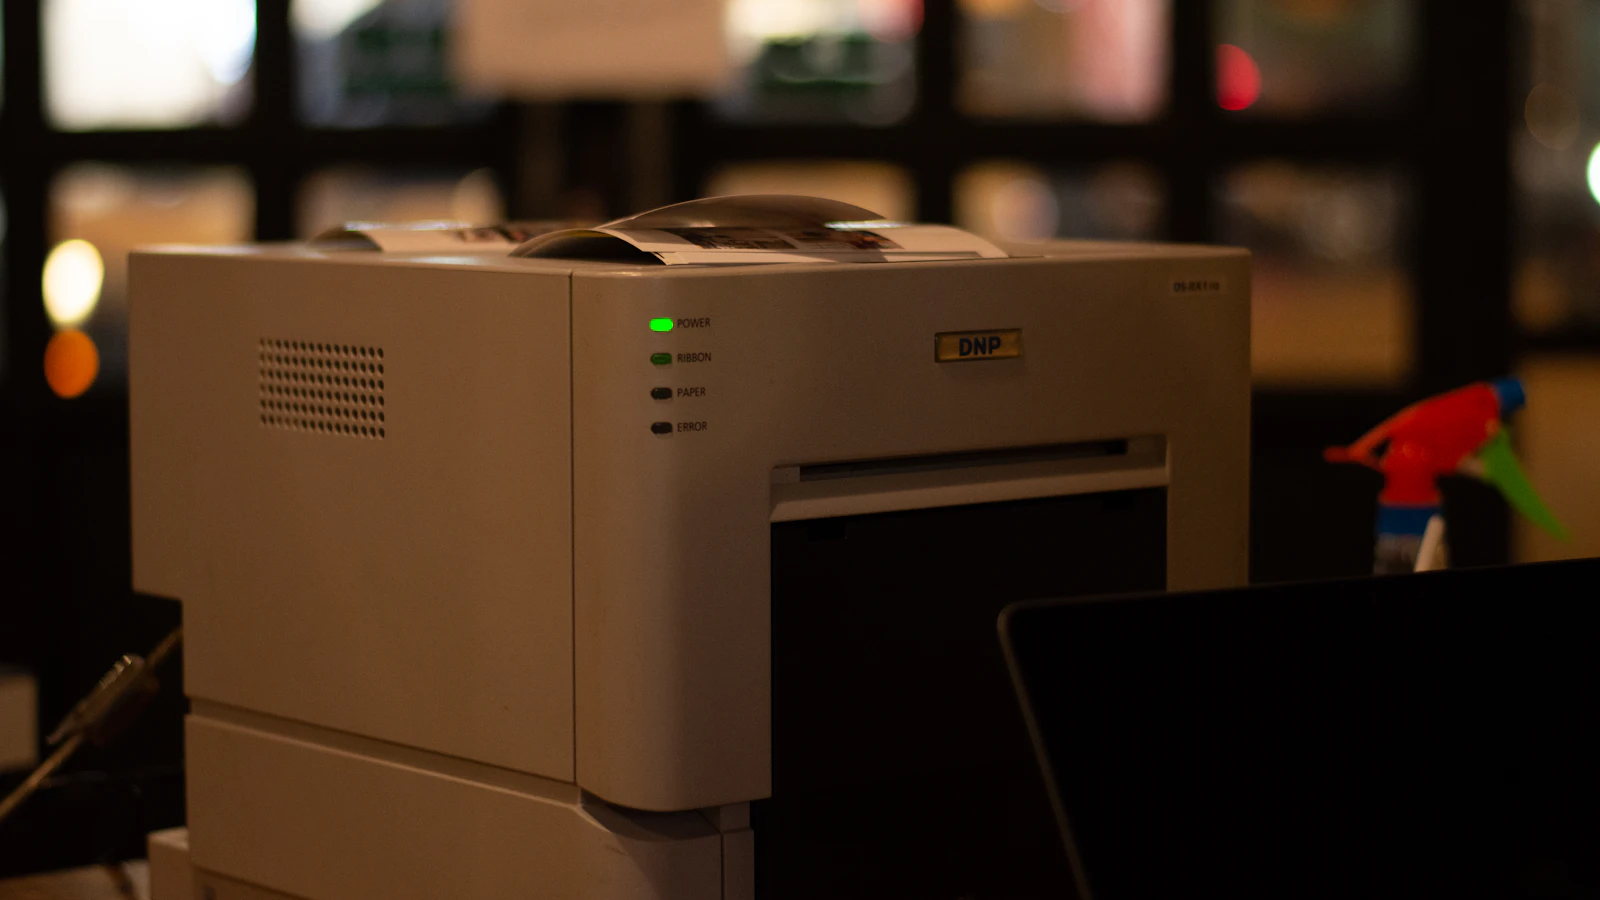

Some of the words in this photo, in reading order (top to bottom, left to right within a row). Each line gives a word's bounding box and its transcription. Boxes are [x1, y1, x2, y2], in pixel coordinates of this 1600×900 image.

[677, 317, 711, 329] POWER
[958, 336, 1001, 357] DNP
[677, 352, 712, 363] RIBBON
[677, 387, 706, 398] PAPER
[677, 421, 708, 433] ERROR
